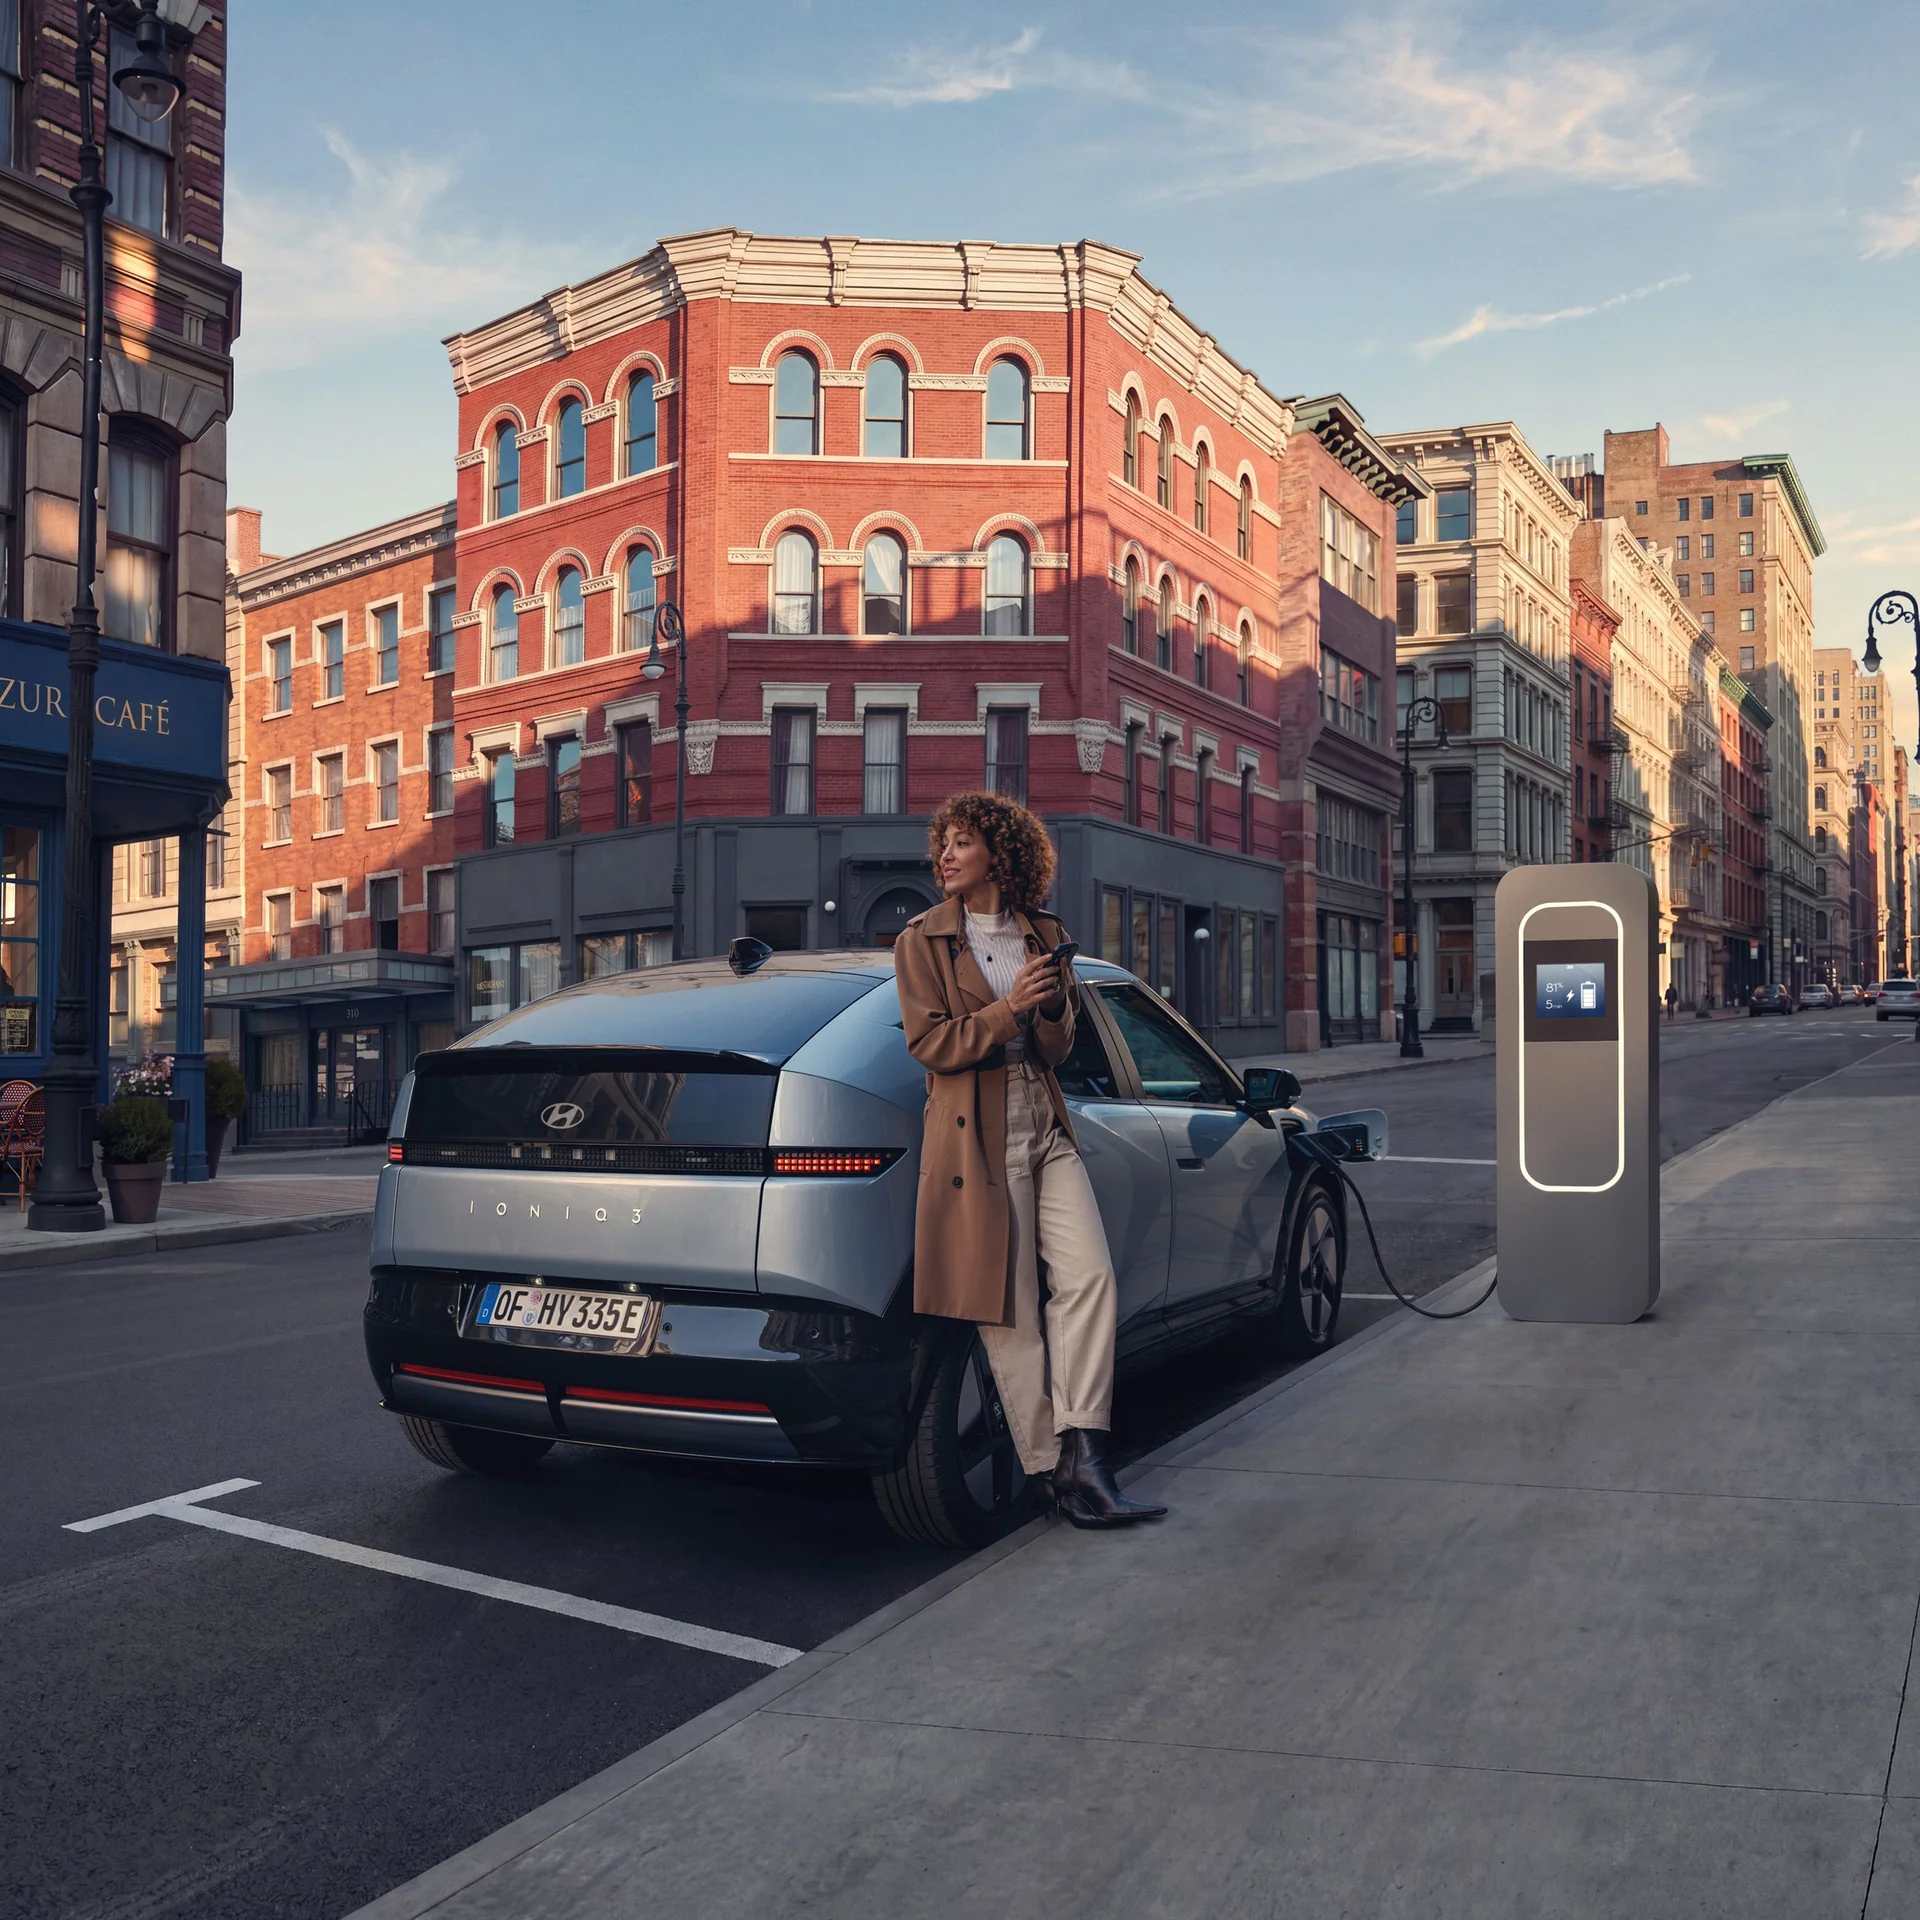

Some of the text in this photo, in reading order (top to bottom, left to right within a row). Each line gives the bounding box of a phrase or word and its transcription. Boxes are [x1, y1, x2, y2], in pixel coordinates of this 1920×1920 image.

[95, 695, 170, 736] CAFÉ
[896, 906, 906, 914] 15
[1545, 982, 1564, 993] 81%
[346, 1008, 360, 1019] 310
[493, 1290, 529, 1322] OF
[482, 1308, 489, 1318] D
